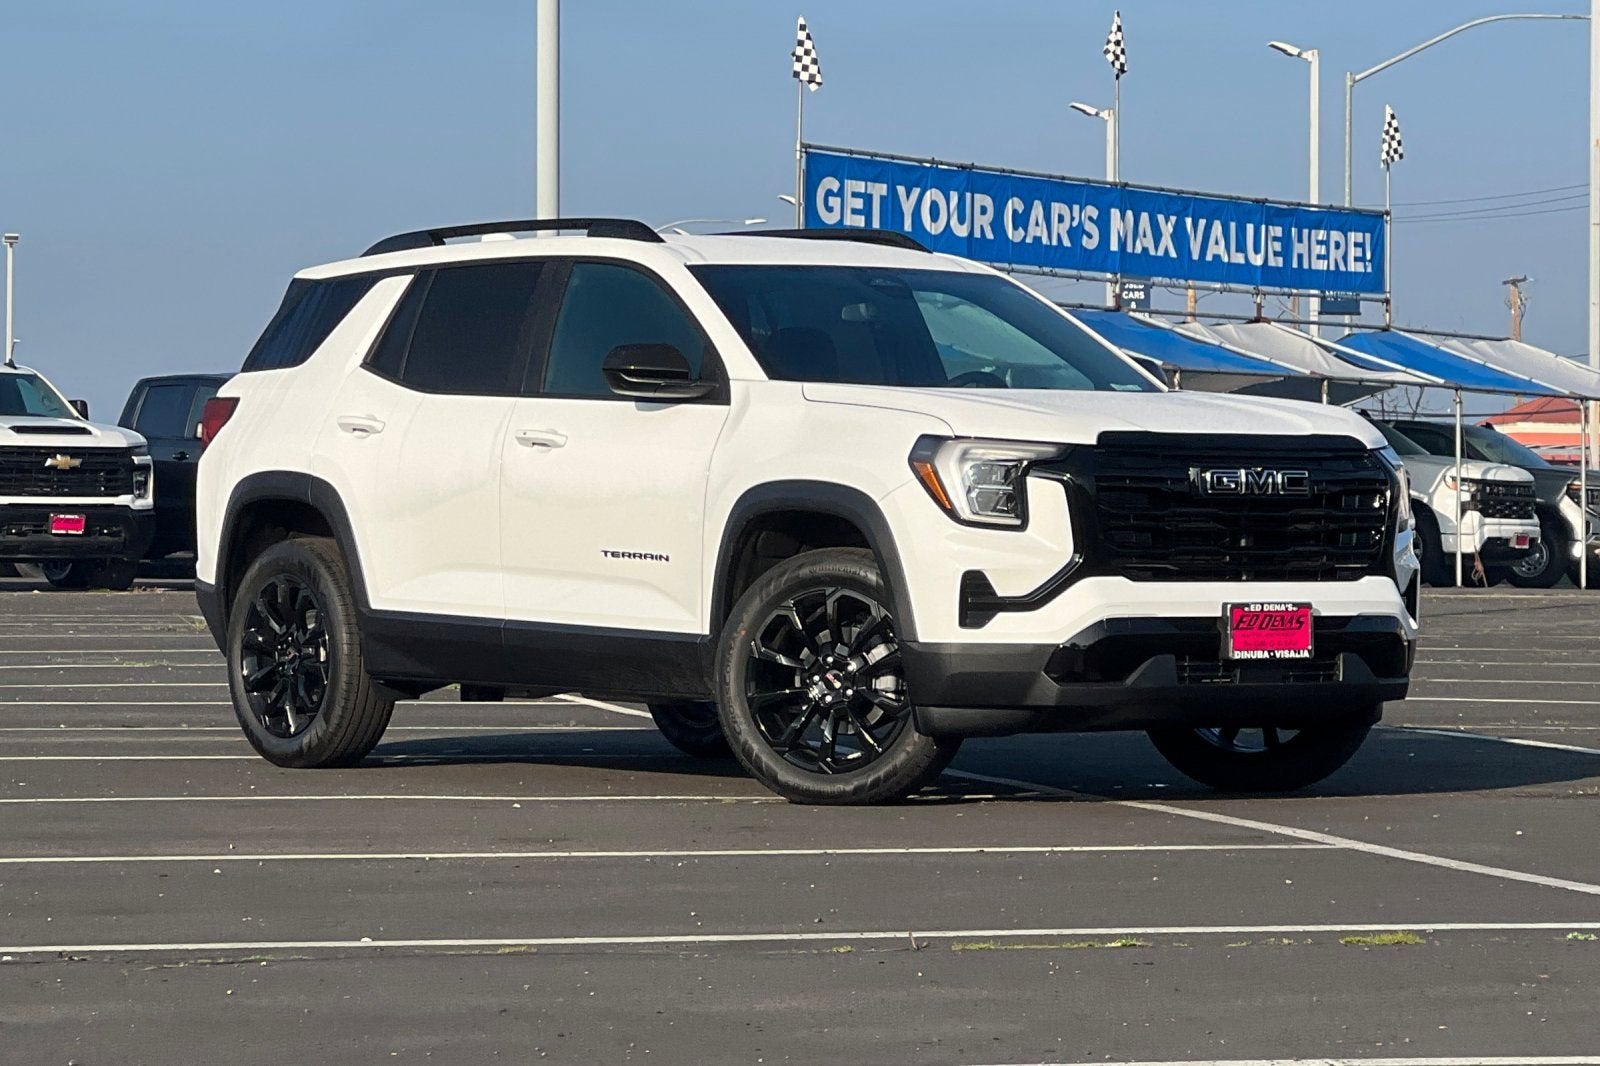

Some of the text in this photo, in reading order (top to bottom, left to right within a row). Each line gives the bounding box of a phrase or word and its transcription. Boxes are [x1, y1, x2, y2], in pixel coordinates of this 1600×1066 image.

[816, 176, 1373, 273] GET YOUR CAR'S MAX VALUE HERE!
[1122, 291, 1144, 299] CARS
[1205, 468, 1309, 494] GMC
[600, 550, 670, 562] TERRAIN
[1275, 650, 1309, 658] VISALIA
